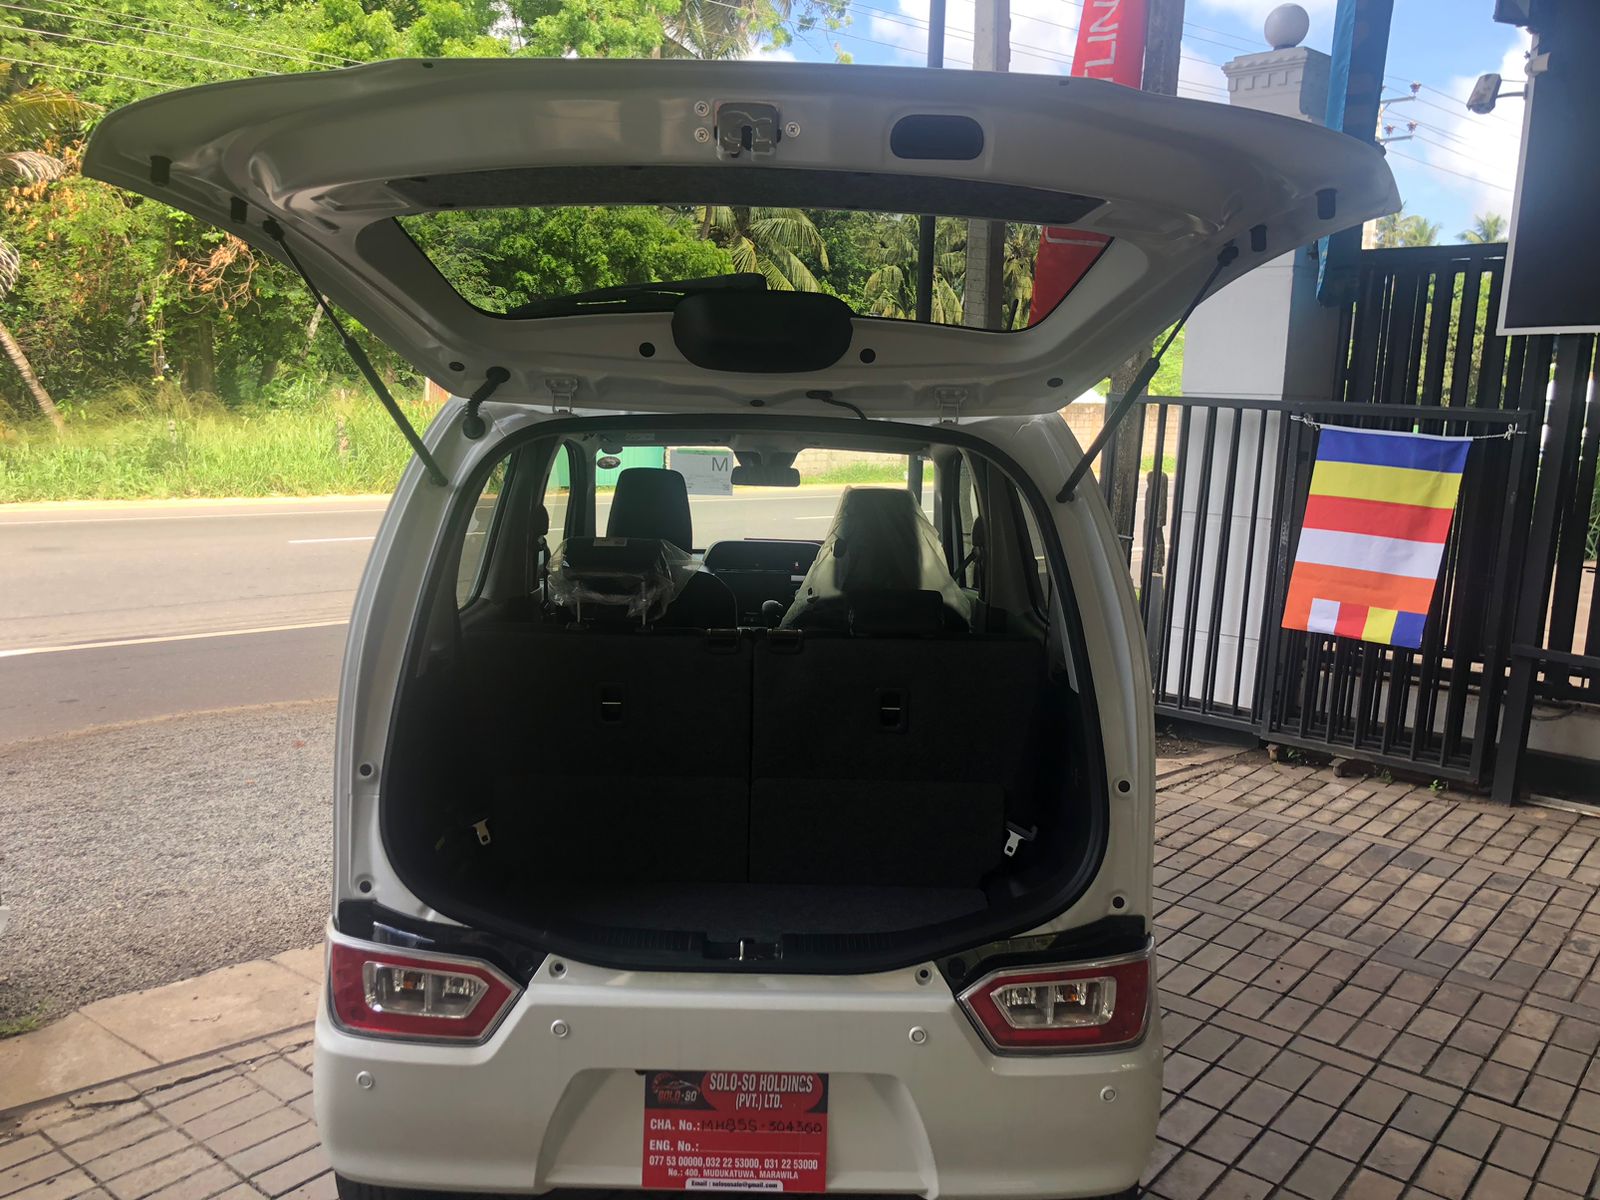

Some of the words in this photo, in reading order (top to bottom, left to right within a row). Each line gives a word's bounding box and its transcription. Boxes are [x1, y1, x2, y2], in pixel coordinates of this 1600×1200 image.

[711, 456, 728, 472] M
[709, 1072, 756, 1092] SOLO-SO
[735, 1093, 763, 1111] (PVT.)
[764, 1093, 783, 1109] LTD.
[650, 1118, 675, 1131] CHA.
[679, 1119, 700, 1131] No.:
[649, 1139, 674, 1151] ENG.
[677, 1140, 699, 1152] No.:
[649, 1155, 664, 1166] 077
[666, 1156, 677, 1166] 53
[722, 1157, 733, 1168] 22
[764, 1158, 778, 1169] 031
[781, 1159, 791, 1169] 22
[793, 1159, 818, 1170] 53000
[759, 1170, 799, 1180] MARAWILA
